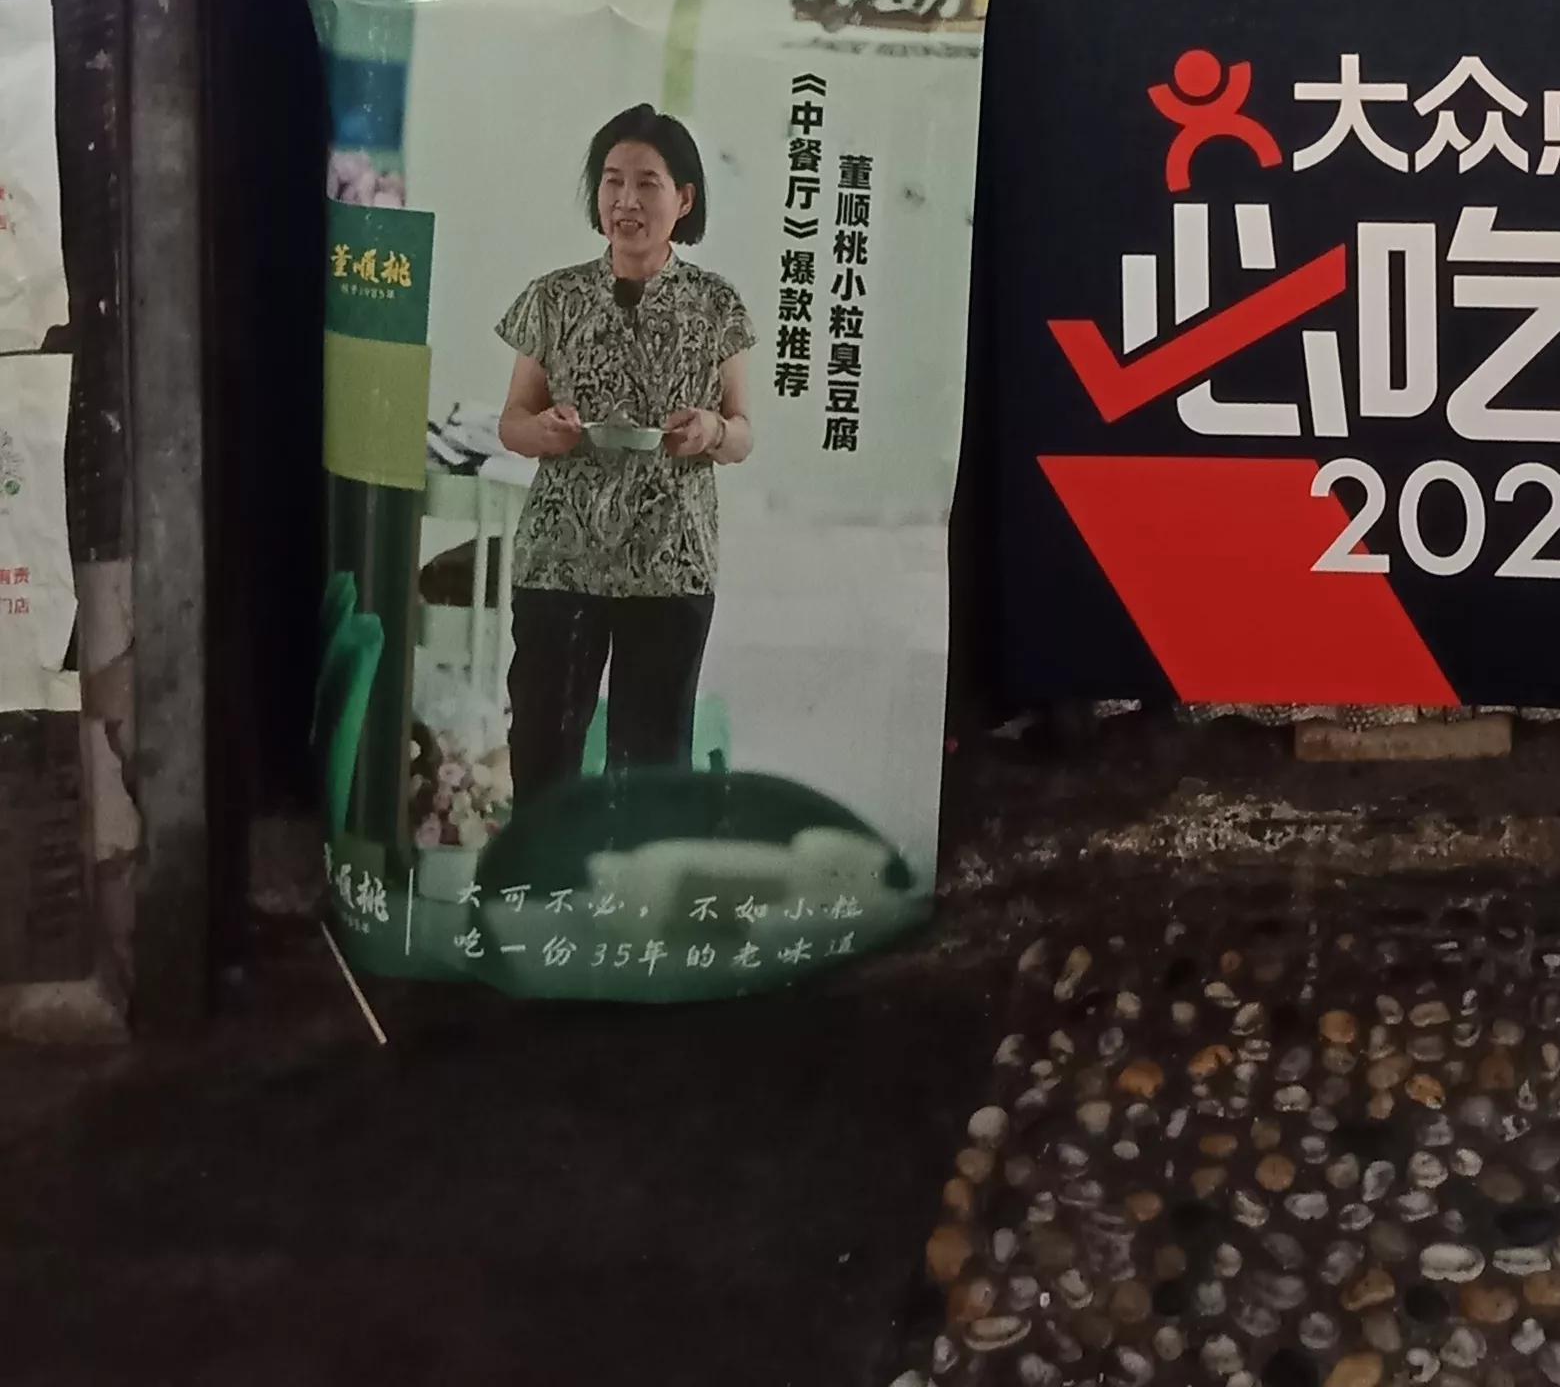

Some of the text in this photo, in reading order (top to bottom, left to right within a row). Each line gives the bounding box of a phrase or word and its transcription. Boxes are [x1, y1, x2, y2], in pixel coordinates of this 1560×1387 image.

[774, 72, 827, 399] 《中餐厅》爆款推荐
[822, 153, 874, 453] 董顺桃小粒臭豆腐
